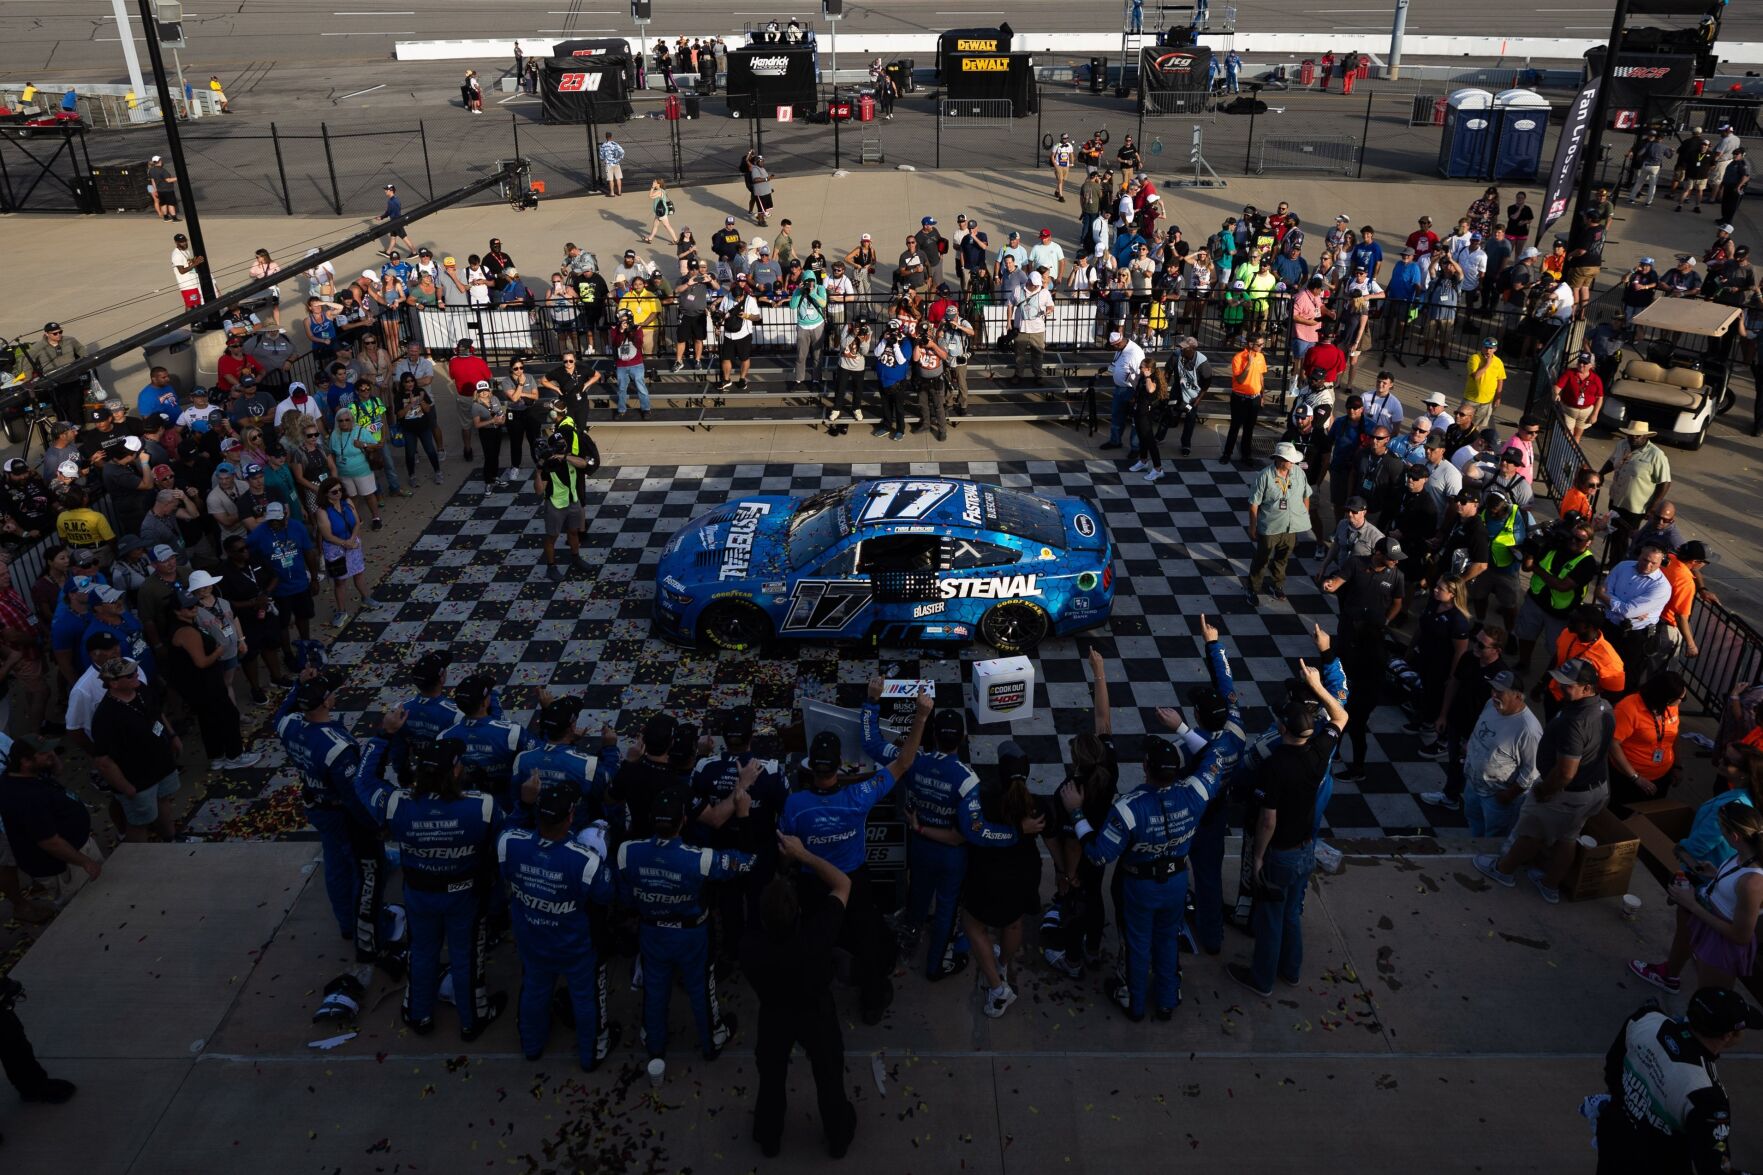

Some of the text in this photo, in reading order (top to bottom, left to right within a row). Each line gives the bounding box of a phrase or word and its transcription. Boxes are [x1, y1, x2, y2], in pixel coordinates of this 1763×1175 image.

[750, 56, 789, 68] Hendrick
[1577, 88, 1596, 120] Fan
[864, 482, 953, 519] 17
[963, 483, 982, 524] FASTENAL
[63, 521, 89, 532] R.M.C.
[938, 573, 1042, 599] STENAL
[780, 580, 873, 633] 17
[994, 684, 1024, 694] COOK OUT
[807, 828, 856, 845] FASTENAL
[982, 828, 1013, 840] FASTENAL
[1131, 826, 1196, 854] FASTENAL
[401, 842, 477, 860] FASTENAL
[538, 838, 553, 848] 17
[656, 839, 670, 847] 17
[511, 881, 577, 915] FASTENAL
[632, 887, 694, 904] FASTENAL
